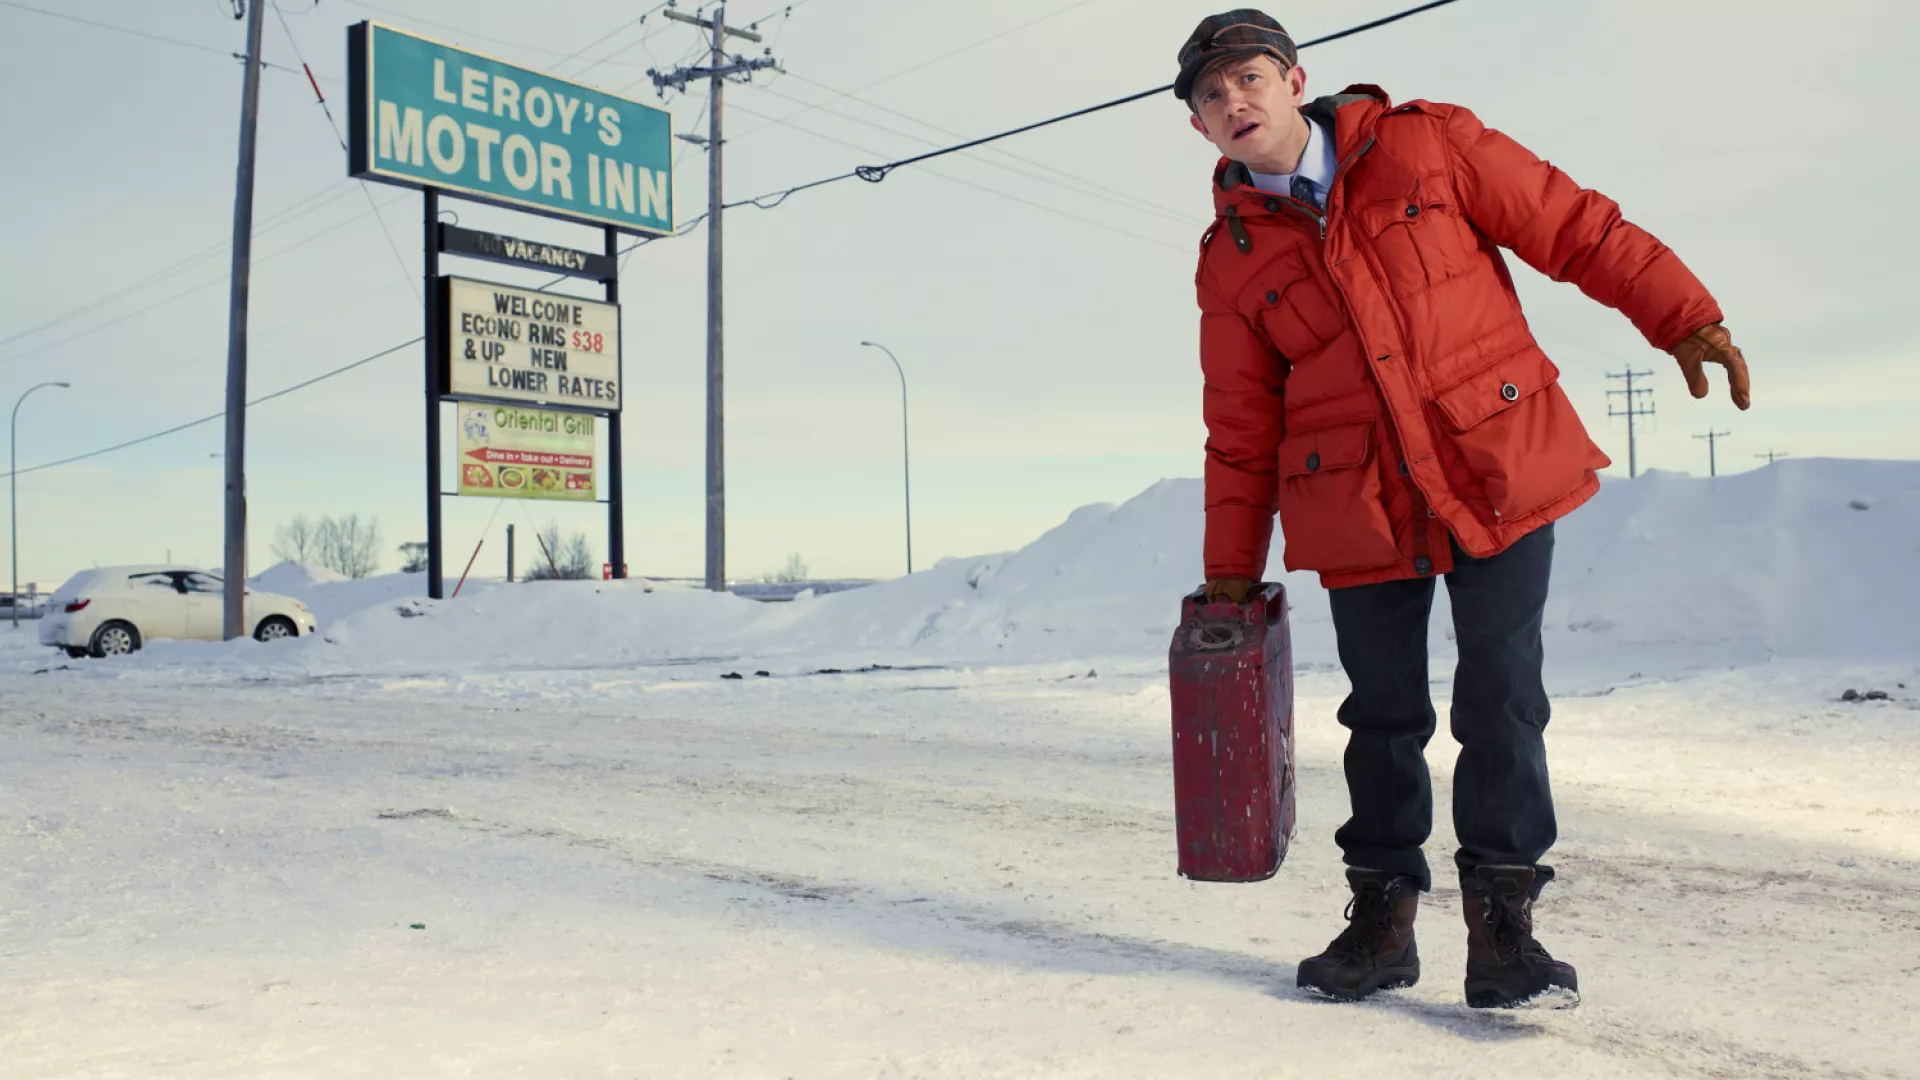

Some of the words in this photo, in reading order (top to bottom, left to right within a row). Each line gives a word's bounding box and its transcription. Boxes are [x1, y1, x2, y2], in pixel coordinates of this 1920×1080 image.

[434, 58, 622, 147] LEROY'S
[379, 99, 573, 201] MOTOR
[588, 153, 668, 221] INN
[503, 239, 587, 270] VACANCY
[494, 292, 583, 325] WELCOME
[462, 312, 521, 340] ECONO
[529, 322, 566, 348] RMS
[572, 331, 604, 353] $38
[464, 338, 477, 360] &
[481, 340, 505, 362] UP
[531, 347, 568, 371] NEW
[488, 366, 548, 392] LOWER
[558, 374, 616, 401] RATES
[494, 407, 558, 433] Oriental
[563, 415, 594, 436] Grill
[486, 450, 505, 460] Dine
[506, 450, 514, 460] in
[540, 454, 553, 463] out
[559, 456, 590, 467] Delivery
